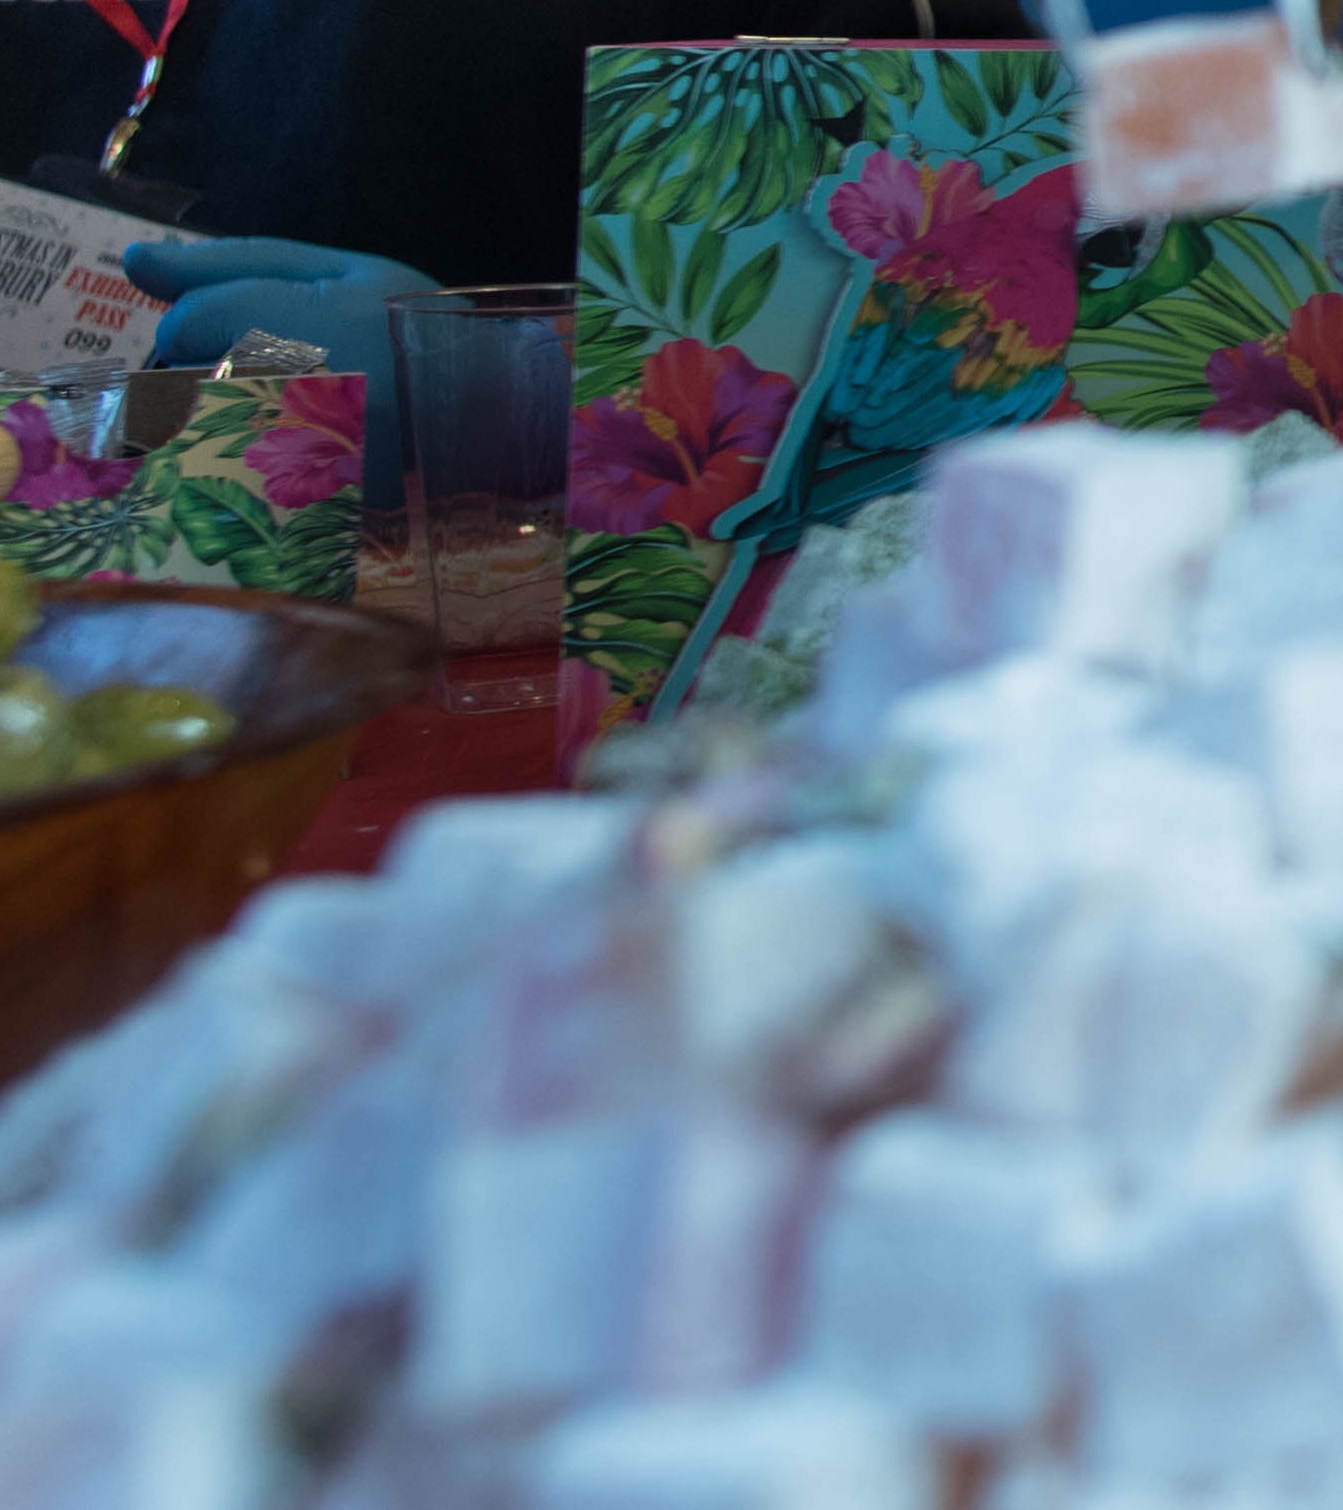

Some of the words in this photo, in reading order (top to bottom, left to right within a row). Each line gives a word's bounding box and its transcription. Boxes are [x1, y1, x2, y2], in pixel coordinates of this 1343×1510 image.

[0, 228, 56, 264] TMAS
[75, 298, 131, 331] PASS
[64, 327, 112, 355] 099
